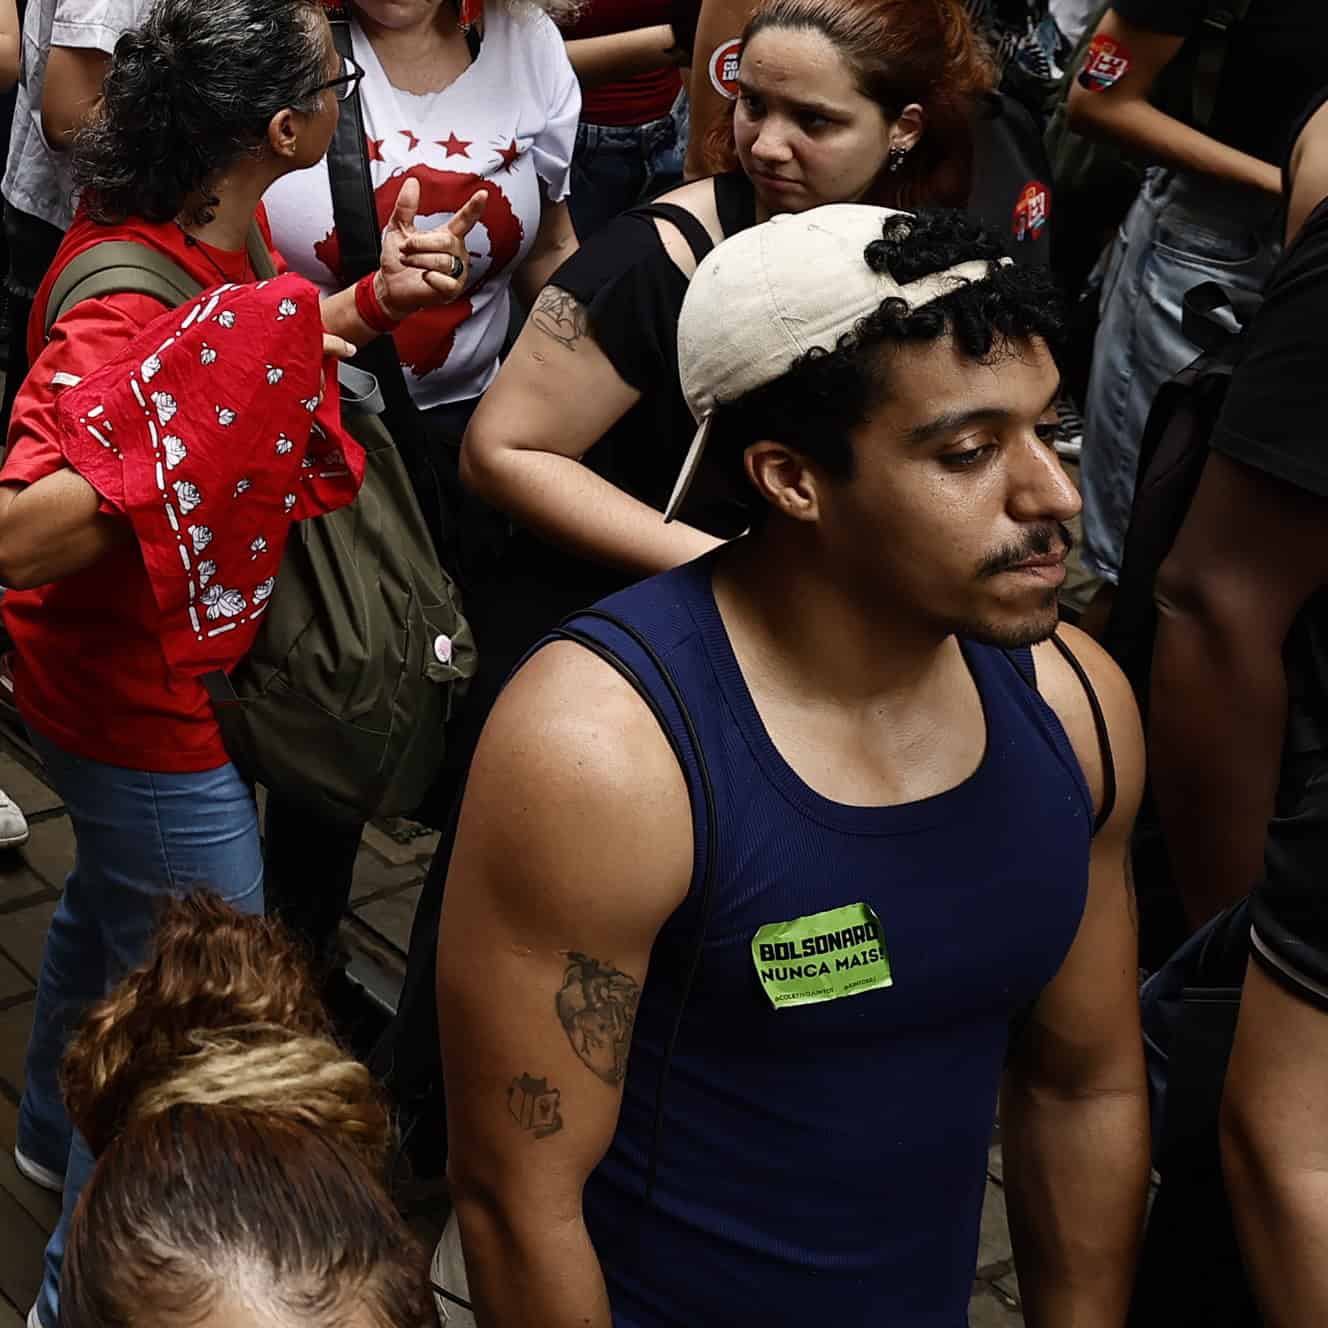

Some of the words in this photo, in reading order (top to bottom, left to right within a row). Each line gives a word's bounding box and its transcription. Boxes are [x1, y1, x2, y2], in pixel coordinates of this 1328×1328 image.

[759, 922, 880, 962] BOLSONARO
[761, 961, 831, 983] NUNCA
[835, 946, 886, 972] MAIS!
